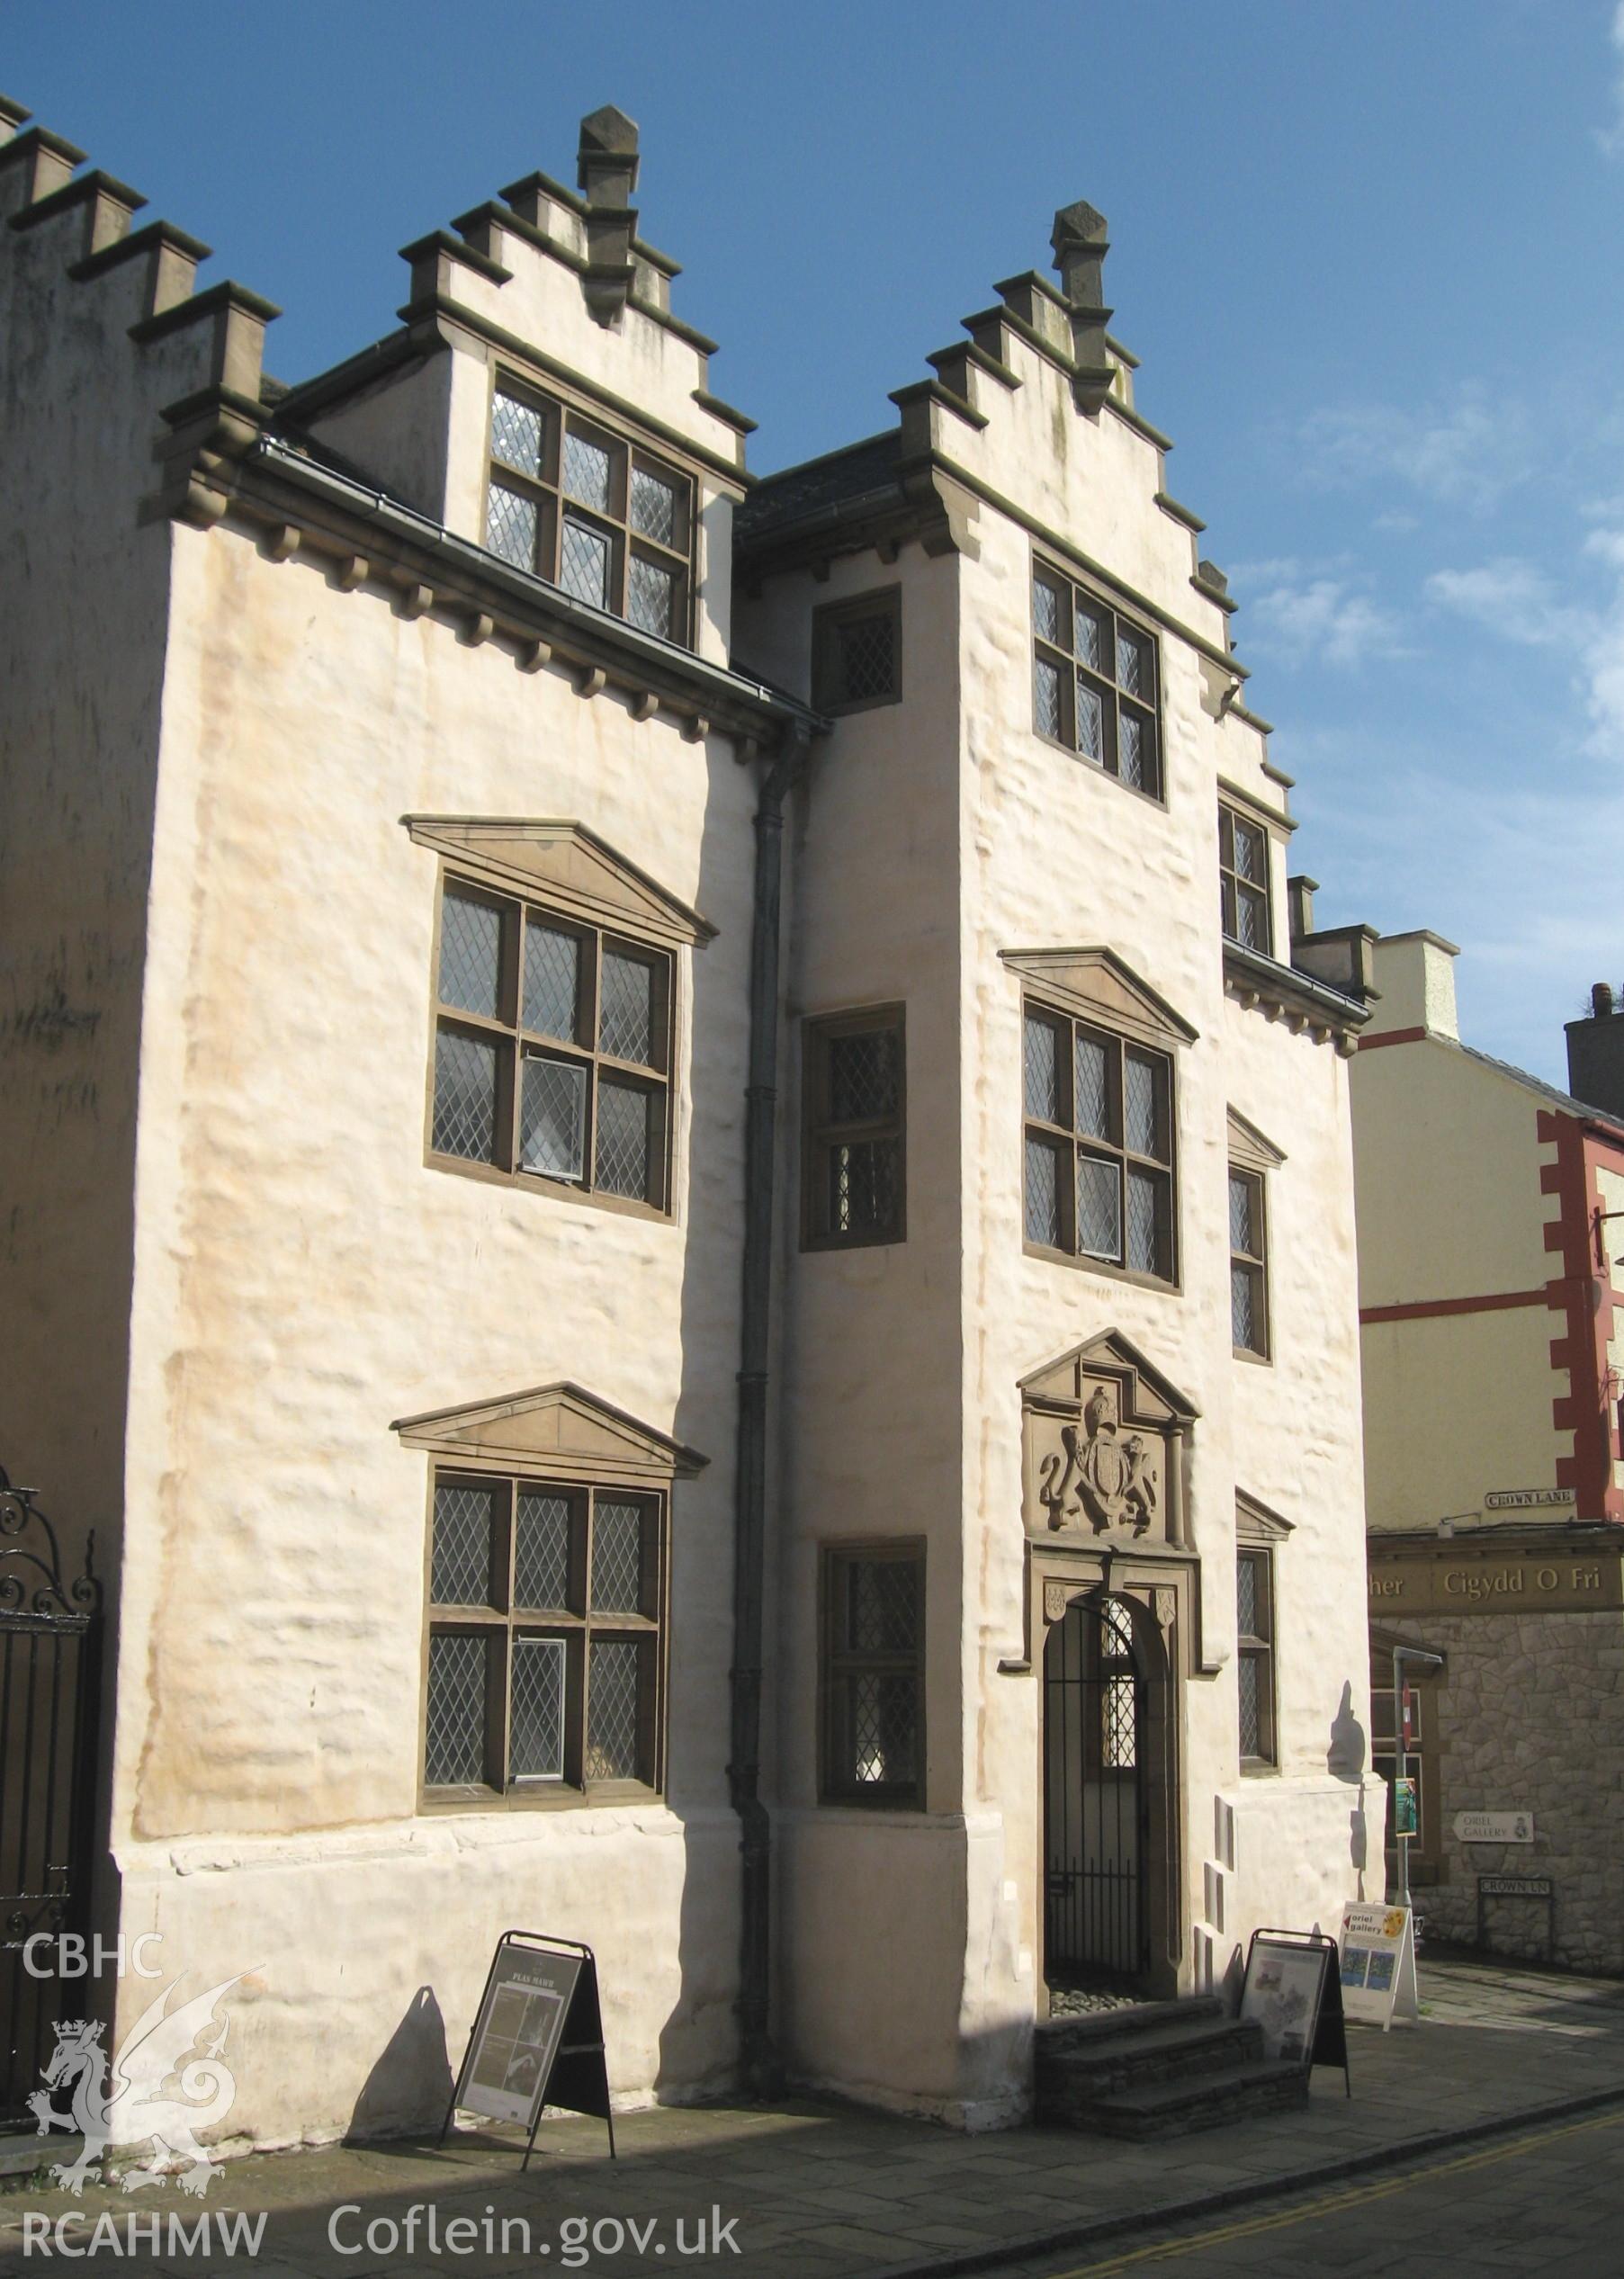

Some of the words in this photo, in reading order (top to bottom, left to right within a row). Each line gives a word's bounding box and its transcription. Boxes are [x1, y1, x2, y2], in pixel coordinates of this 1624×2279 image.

[1535, 1490, 1571, 1503] LANE
[1444, 1568, 1523, 1601] Cigydd
[1536, 1568, 1558, 1590] O
[1571, 1566, 1601, 1589] Fri
[1463, 1826, 1507, 1836] GALLERY
[1481, 1880, 1527, 1893] CROWN
[1530, 1882, 1548, 1893] LN
[1352, 1913, 1373, 1923] oriel
[1350, 1923, 1382, 1934] gallery
[512, 1972, 532, 1983] PLAS
[533, 1976, 555, 1987] MAWR
